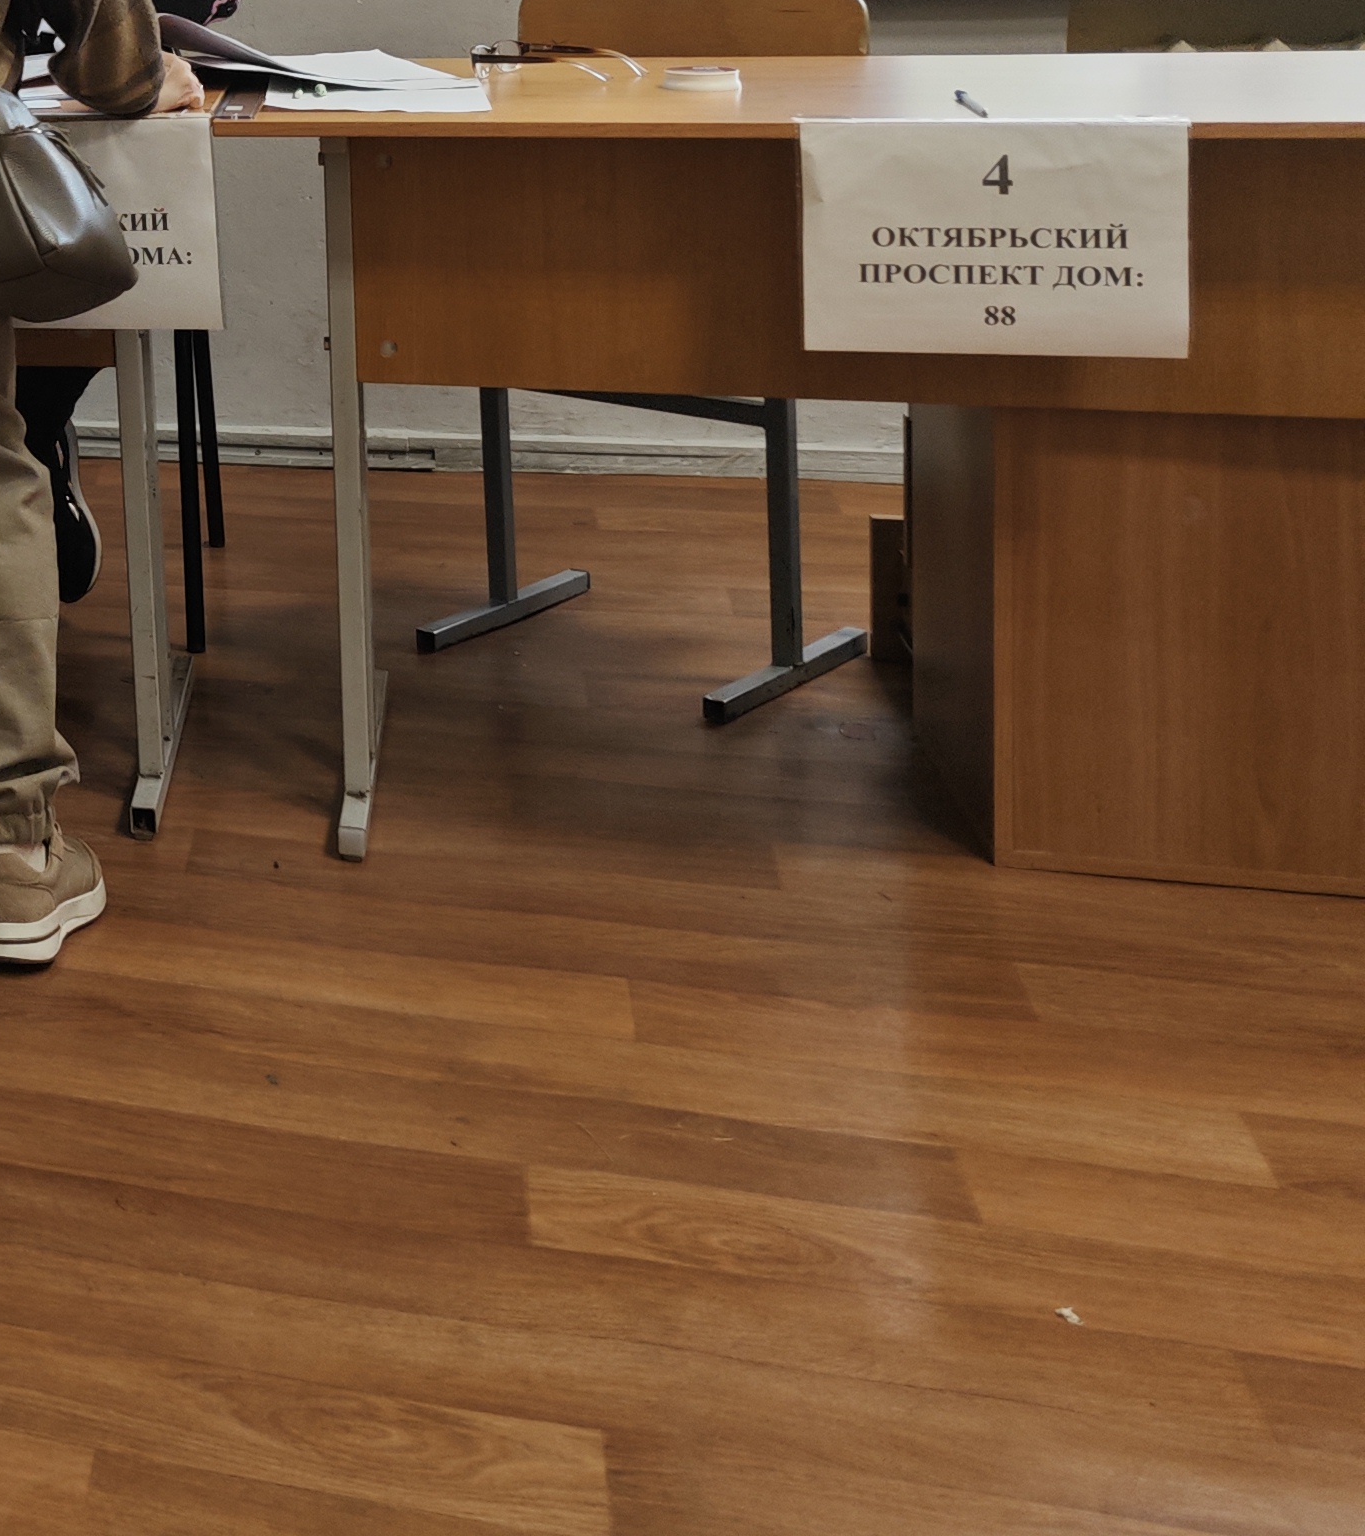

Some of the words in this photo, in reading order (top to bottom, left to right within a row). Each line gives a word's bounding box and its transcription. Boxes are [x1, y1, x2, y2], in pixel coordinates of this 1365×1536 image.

[981, 154, 1014, 195] 4
[871, 223, 1129, 249] ОКТЯБРЬСКИЙ
[858, 263, 1044, 285] ПРОСПЕКТ
[1052, 265, 1145, 291] ДОМ:
[983, 305, 1016, 326] 88
